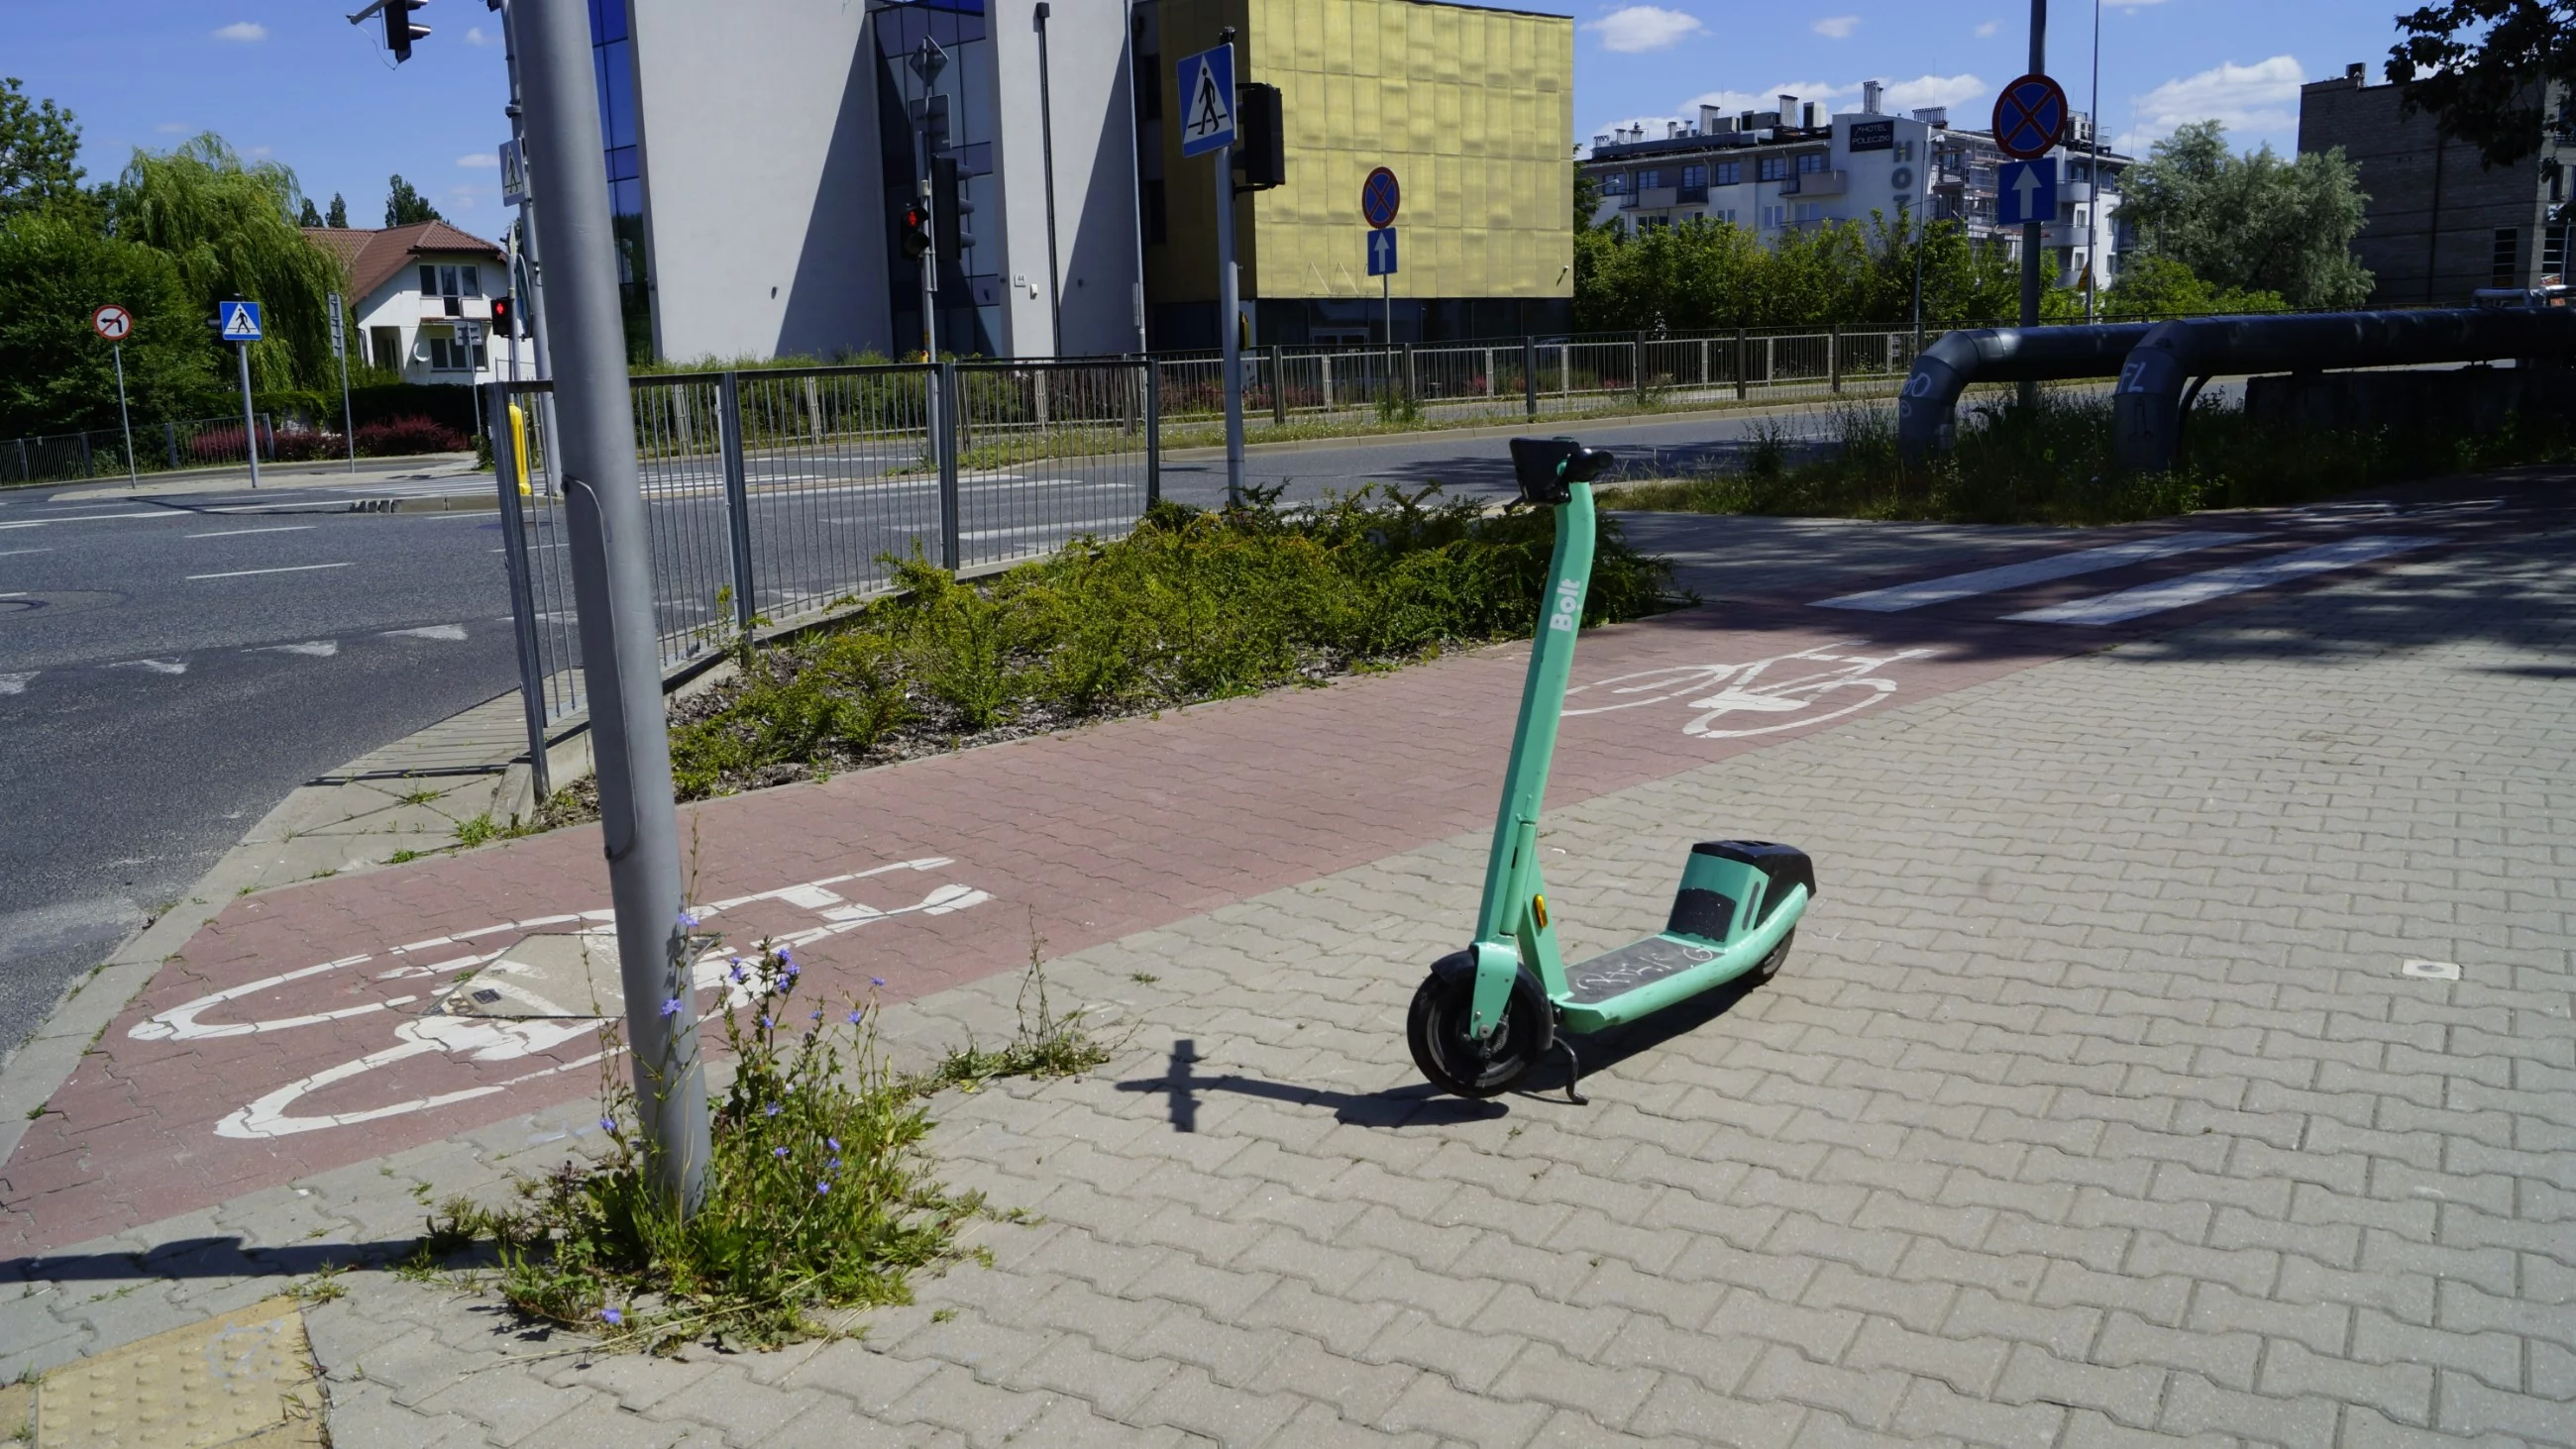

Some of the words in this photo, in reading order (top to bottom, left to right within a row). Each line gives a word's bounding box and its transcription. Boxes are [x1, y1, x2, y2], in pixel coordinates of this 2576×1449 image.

[1862, 124, 1887, 134] HOTEL
[1851, 135, 1890, 146] POLECZKI
[1550, 578, 1581, 632] Bolt
